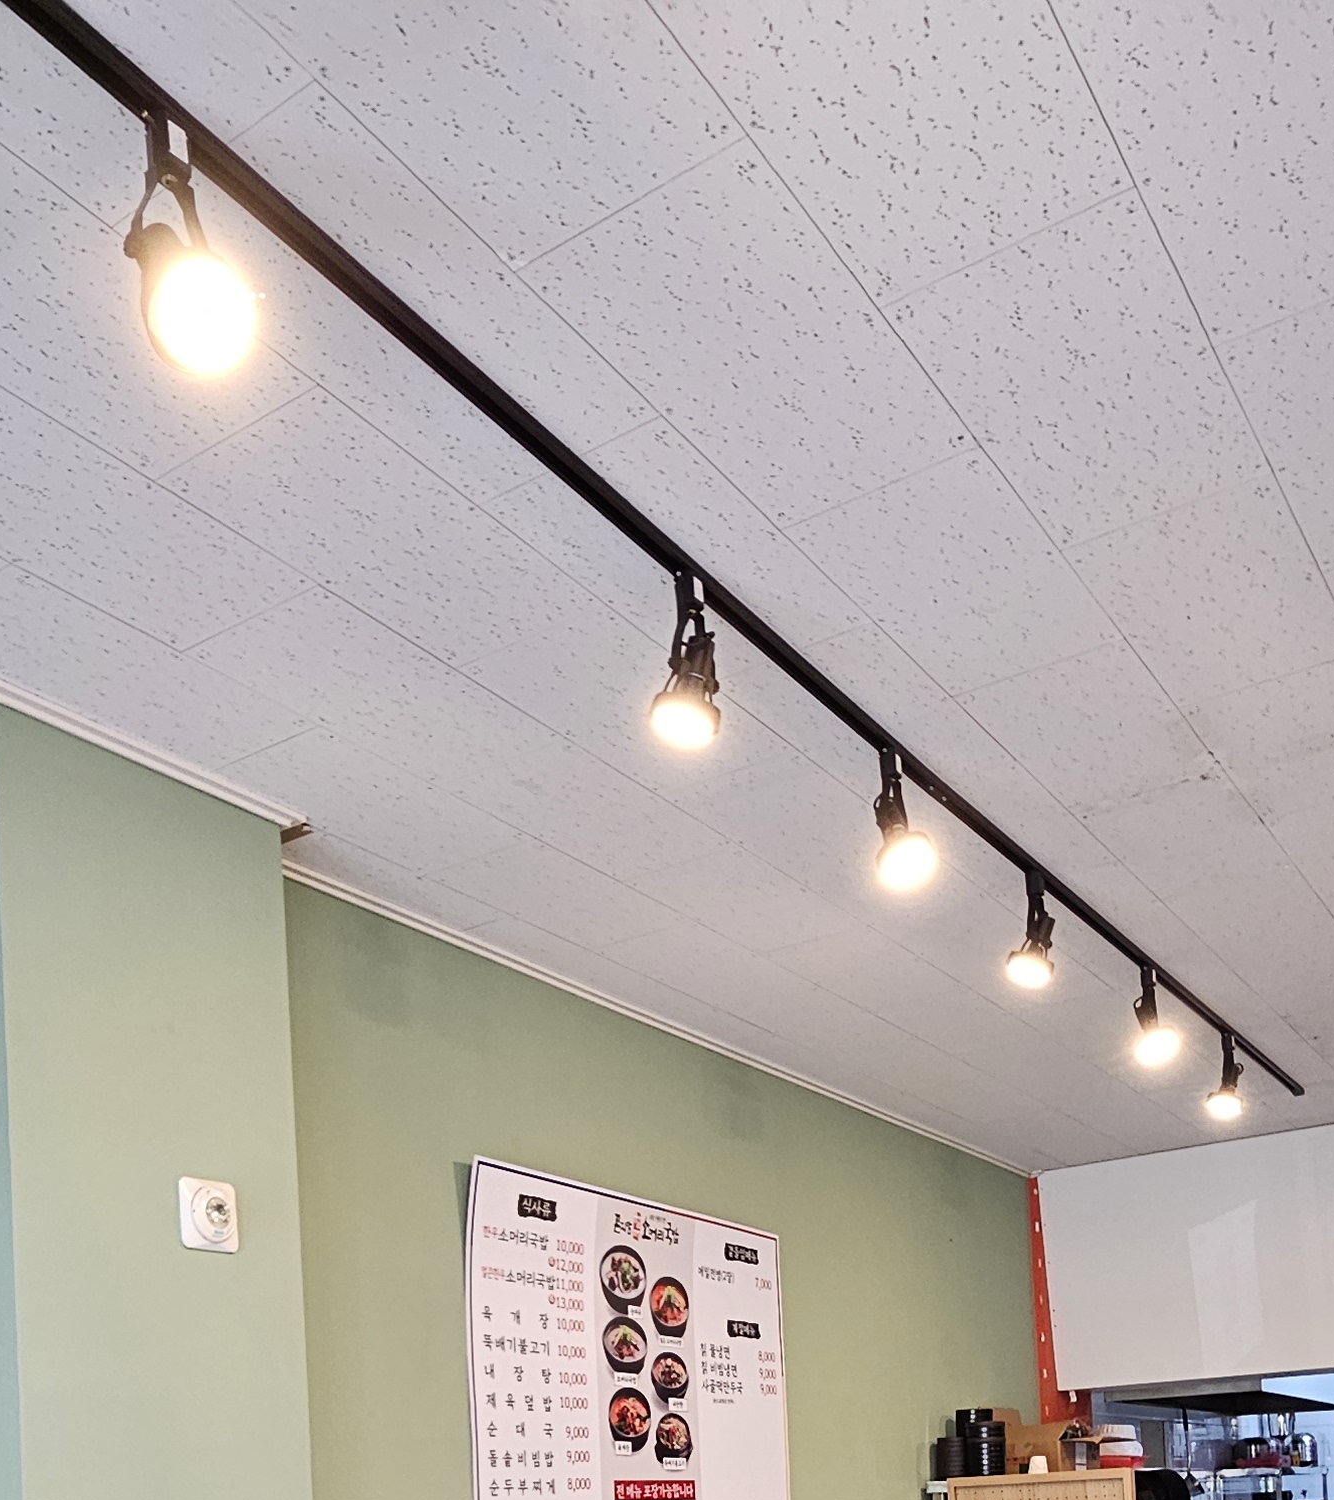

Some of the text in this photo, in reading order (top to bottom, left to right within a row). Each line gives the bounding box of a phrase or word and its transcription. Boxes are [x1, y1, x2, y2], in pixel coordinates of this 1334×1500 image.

[521, 1198, 552, 1217] 식사류
[556, 1239, 585, 1256] 10,000
[556, 1278, 584, 1293] 11,000
[755, 1276, 772, 1291] 7,000
[556, 1317, 585, 1333] 10,000
[558, 1345, 586, 1360] 10,000
[758, 1350, 776, 1363] 8,000
[559, 1372, 587, 1387] 10,000
[759, 1368, 777, 1381] 9,000
[760, 1383, 777, 1396] 9,000
[559, 1396, 589, 1412] 10,000
[565, 1426, 589, 1441] 9,000
[566, 1450, 590, 1465] 9,000
[567, 1477, 591, 1493] 8,000
[616, 1482, 694, 1500] 전 메뉴 포장가능합니다
